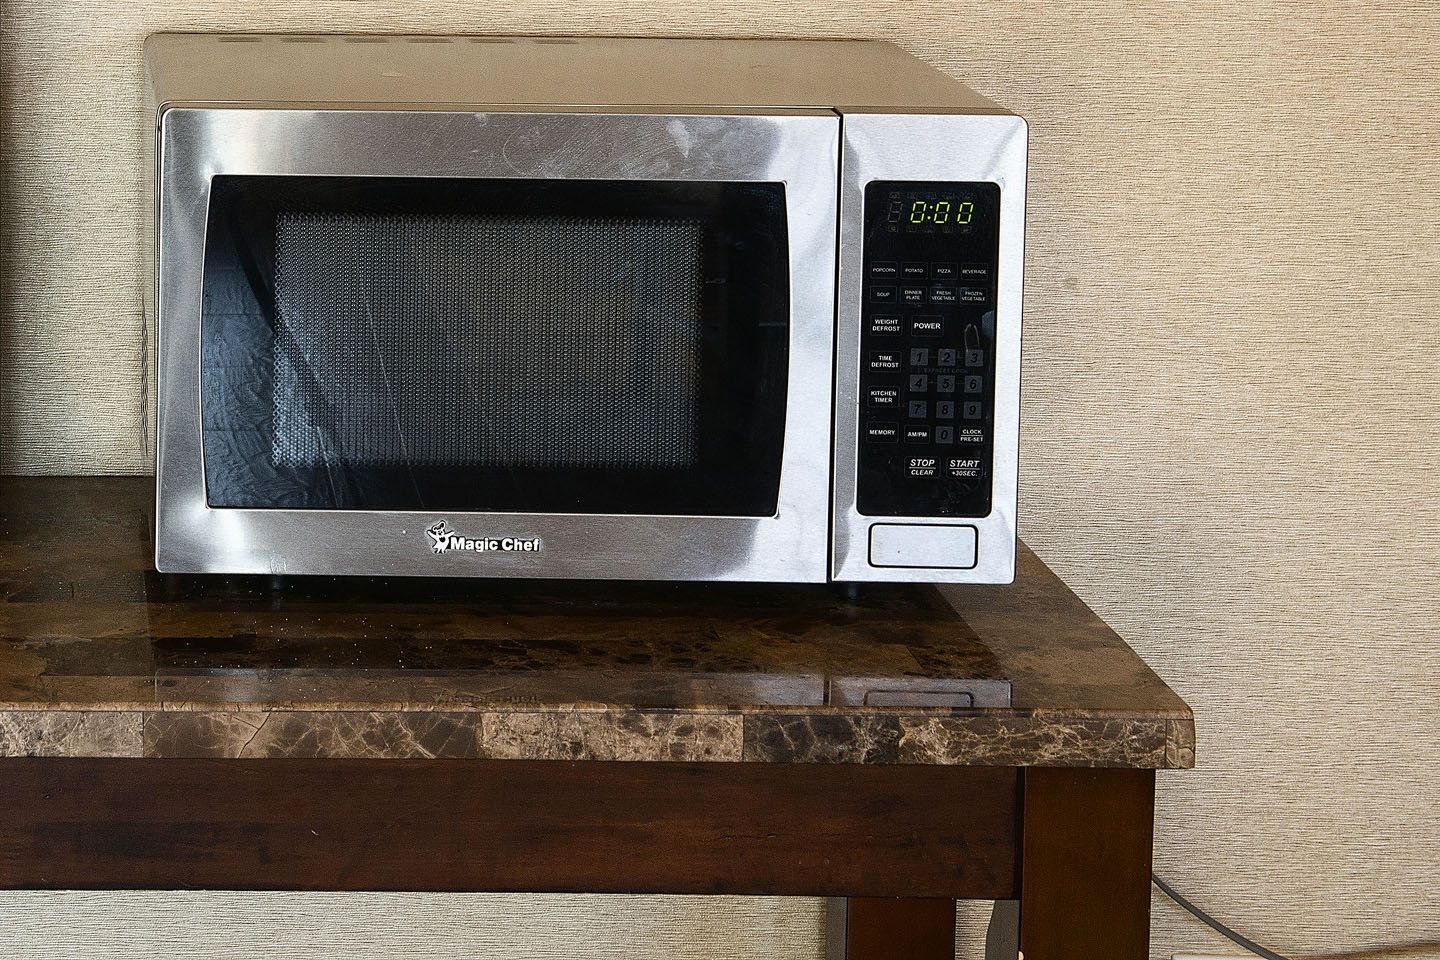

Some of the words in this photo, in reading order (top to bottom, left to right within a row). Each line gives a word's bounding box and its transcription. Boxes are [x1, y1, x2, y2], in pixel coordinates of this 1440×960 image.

[910, 201, 974, 224] 0:00
[913, 322, 941, 330] POWER
[916, 352, 924, 363] 1
[943, 352, 951, 363] 2
[970, 353, 978, 364] 3
[914, 378, 923, 387] 4
[942, 378, 951, 389] 5
[969, 379, 977, 389] 6
[914, 404, 921, 414] 7
[941, 404, 949, 415] 8
[968, 405, 977, 416] 9
[940, 430, 948, 440] 0
[910, 459, 935, 467] STOP
[949, 460, 981, 468] START
[450, 537, 499, 553] Magic
[501, 537, 541, 552] Chef
